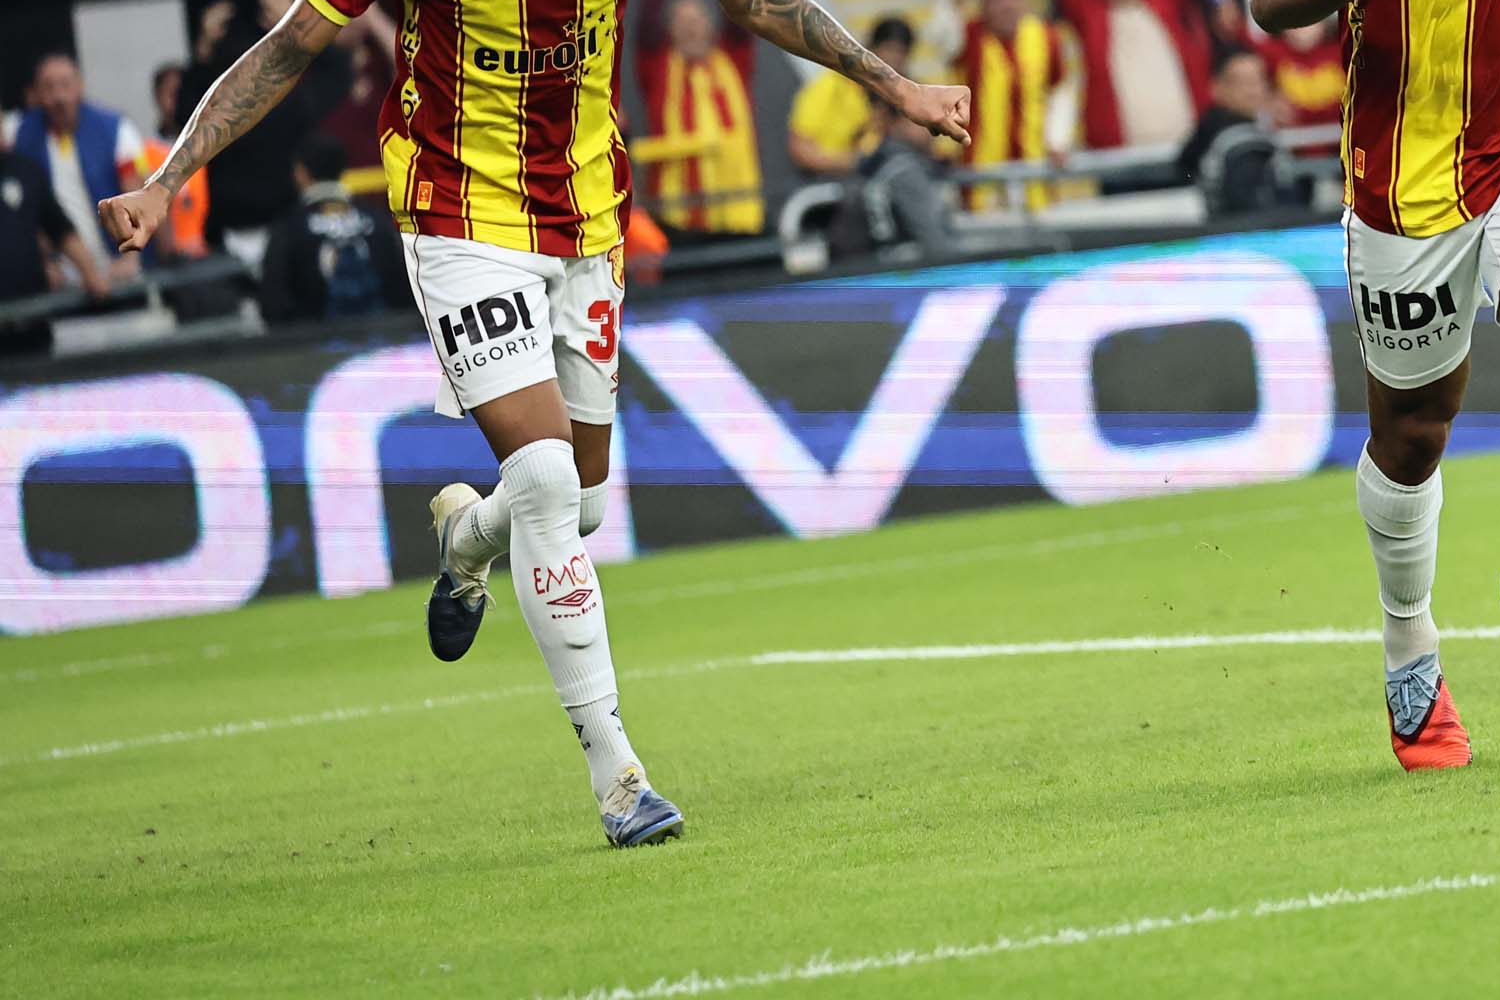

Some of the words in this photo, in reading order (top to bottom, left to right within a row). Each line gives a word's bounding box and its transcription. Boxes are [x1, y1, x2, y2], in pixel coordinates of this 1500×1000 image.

[474, 26, 598, 75] euroil
[438, 291, 536, 357] HDI
[1360, 281, 1458, 331] HDI
[453, 335, 541, 378] SİGORTA
[1366, 321, 1461, 352] SİGORTA
